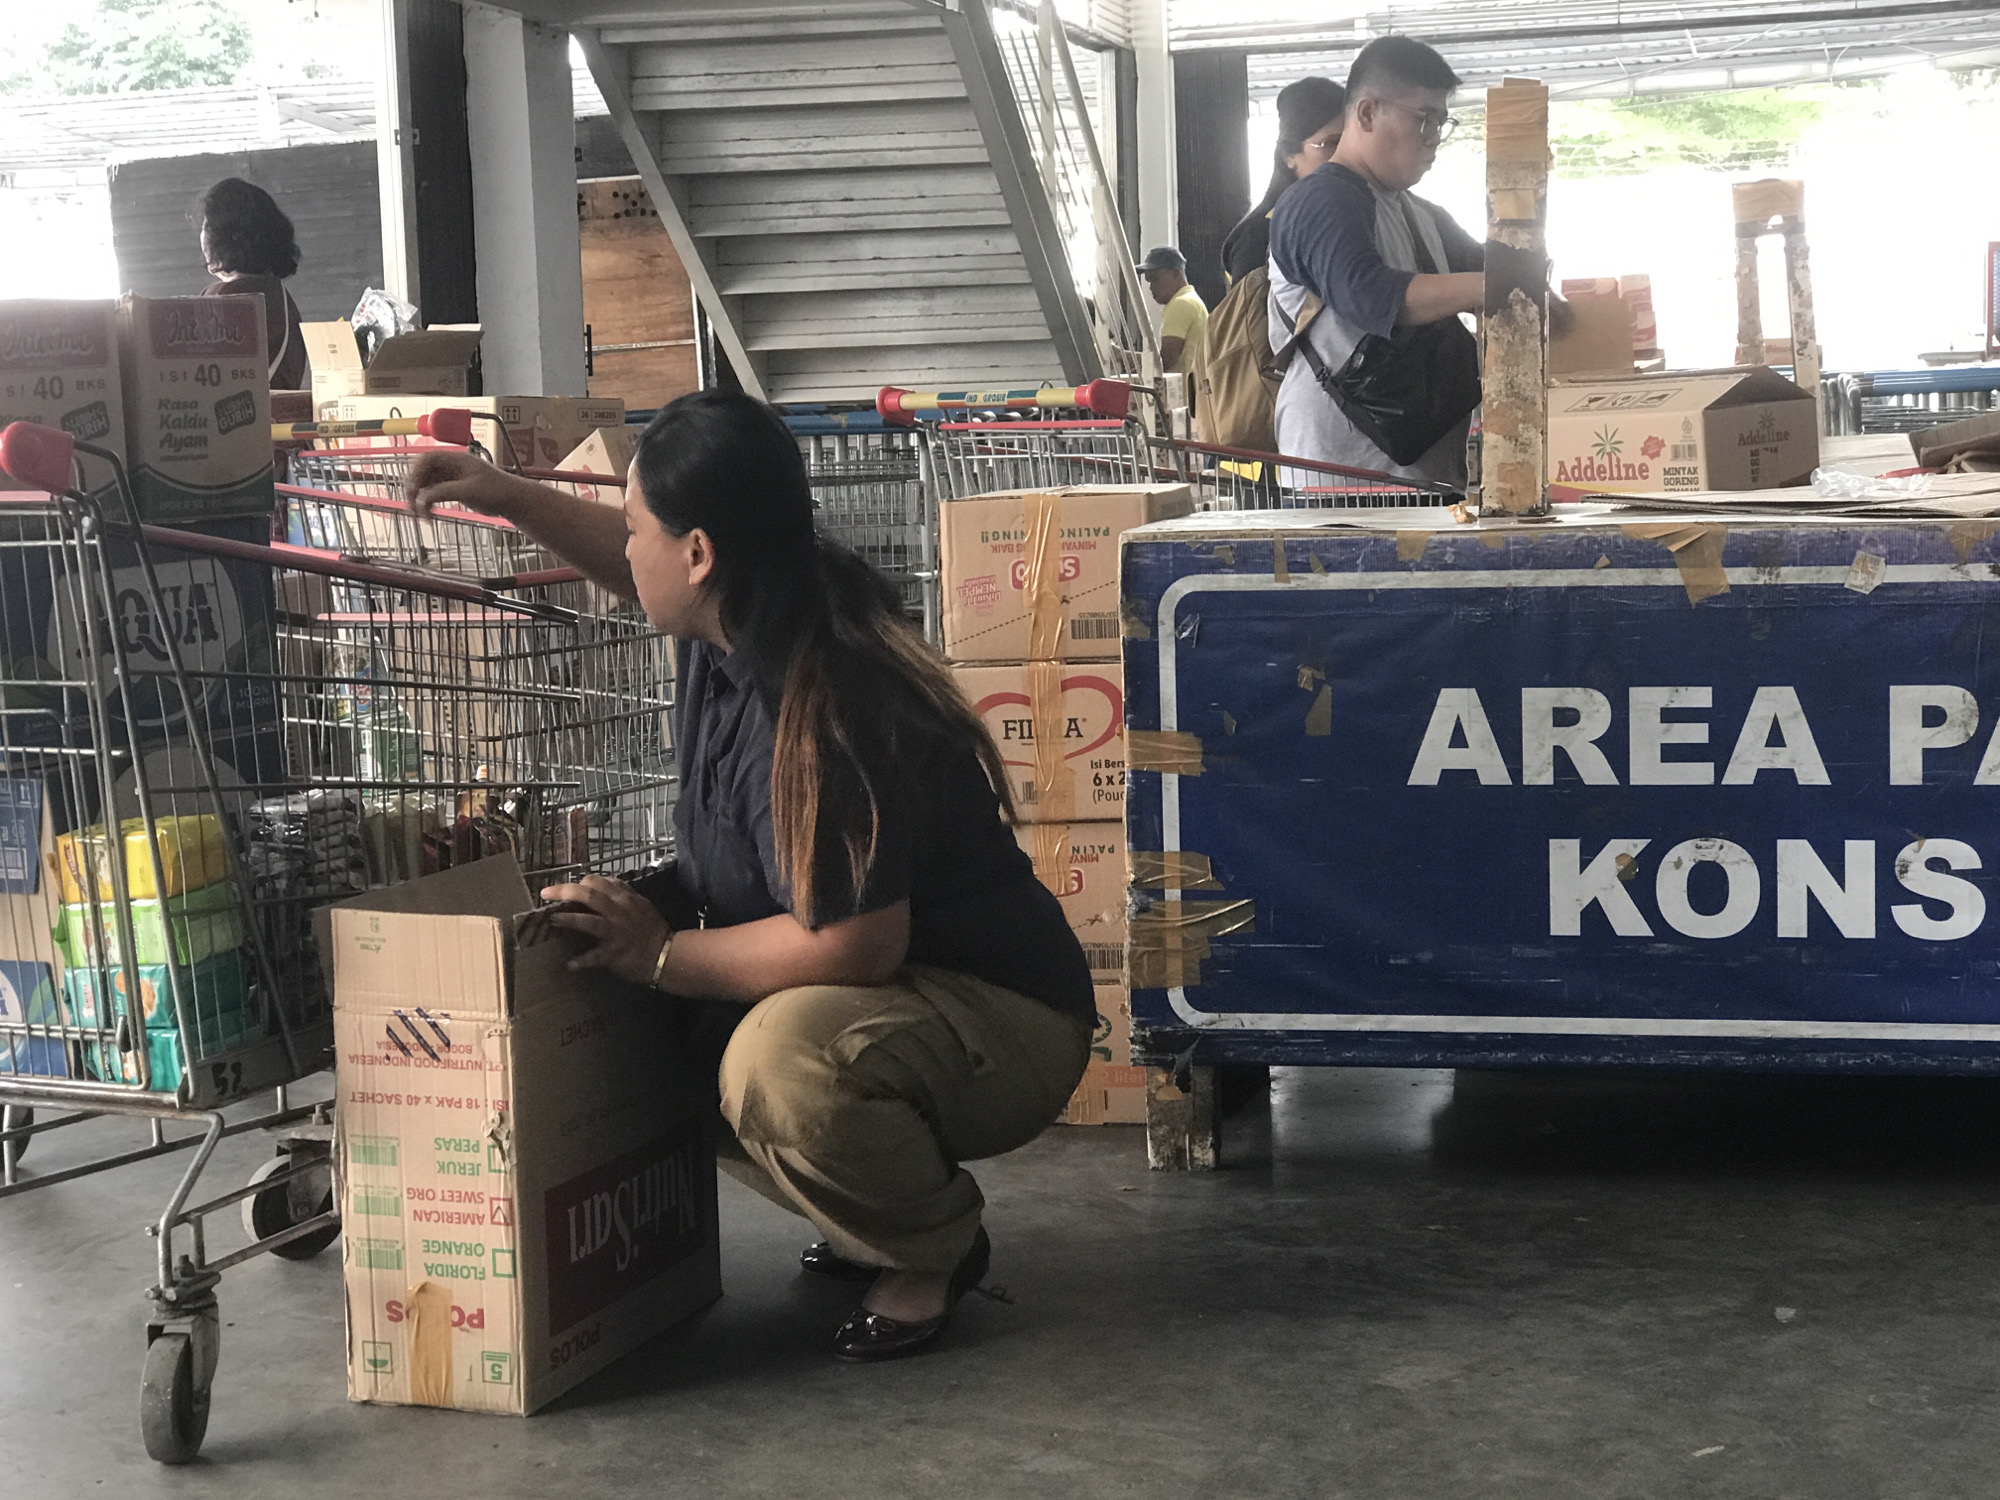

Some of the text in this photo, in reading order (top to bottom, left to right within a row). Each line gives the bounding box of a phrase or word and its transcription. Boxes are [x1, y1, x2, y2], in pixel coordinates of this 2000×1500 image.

[194, 363, 221, 387] 40
[231, 368, 256, 380] BKS
[33, 375, 64, 400] 40
[75, 379, 105, 391] BKS
[158, 398, 198, 410] Rasa
[159, 413, 207, 430] Kaldu
[219, 405, 253, 429] GURIH
[75, 416, 108, 439] URIH
[159, 432, 208, 452] Ayam
[1737, 428, 1790, 447] Addeline
[1556, 452, 1650, 482] Addeline
[1663, 466, 1699, 476] MINYAK
[1663, 477, 1699, 486] GORENG
[991, 543, 1014, 554] BAIK
[1407, 684, 2000, 786] AREA P
[1090, 759, 1101, 769] Isi
[1093, 772, 1102, 786] 6
[1106, 775, 1115, 786] x
[1549, 837, 1986, 941] KONS
[348, 1054, 411, 1068] INDONESIA
[414, 1057, 483, 1071] NUTRIFOOD
[211, 1061, 242, 1097] 52
[349, 1091, 402, 1106] SACHET
[406, 1094, 421, 1107] 40
[424, 1095, 432, 1104] x
[435, 1096, 462, 1109] PAK
[466, 1098, 480, 1110] 18
[492, 1099, 509, 1111] ISI
[434, 1137, 480, 1153] PERAS
[436, 1161, 481, 1176] JERUK
[406, 1187, 436, 1202] ORG
[439, 1189, 485, 1204] SWEET
[413, 1209, 485, 1226] AMERICAN
[422, 1239, 485, 1257] ORANGE
[423, 1262, 486, 1280] FLORIDA
[549, 1322, 602, 1371] POLOS
[490, 1363, 503, 1380] 5
